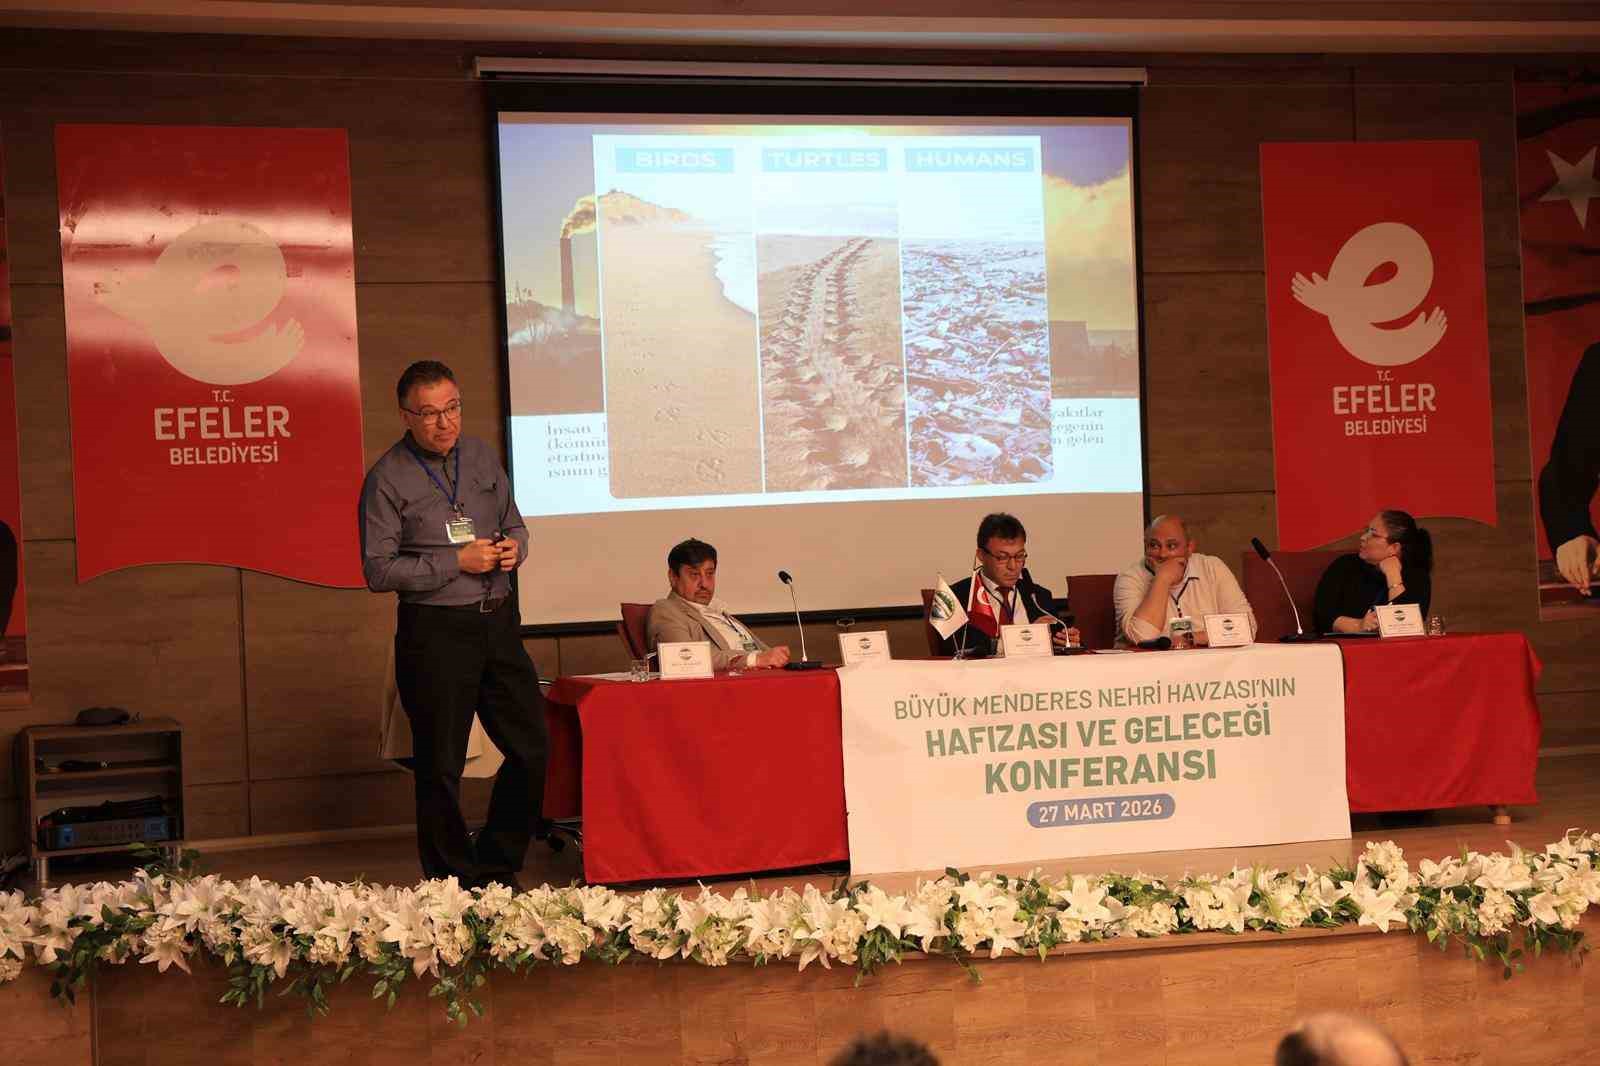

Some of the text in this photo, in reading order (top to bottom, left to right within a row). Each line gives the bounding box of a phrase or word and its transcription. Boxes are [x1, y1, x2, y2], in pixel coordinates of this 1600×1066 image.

[634, 151, 718, 168] BIRDS
[767, 151, 881, 167] TURTLES
[916, 151, 1027, 168] HUMANS
[211, 389, 235, 402] T.C.
[1332, 383, 1437, 415] EFELER
[153, 405, 291, 440] EFELER
[1344, 414, 1428, 436] BELEDİYESİ
[169, 441, 279, 465] BELEDİYESİ
[894, 677, 1296, 720] BÜYÜK MENDERES NEHRİ HAVZASI'NIN
[925, 701, 1271, 757] HAFIZASI VE GELECEĞİ
[984, 749, 1217, 794] KONFERANSI
[1039, 799, 1163, 823] 27 MART 2026
